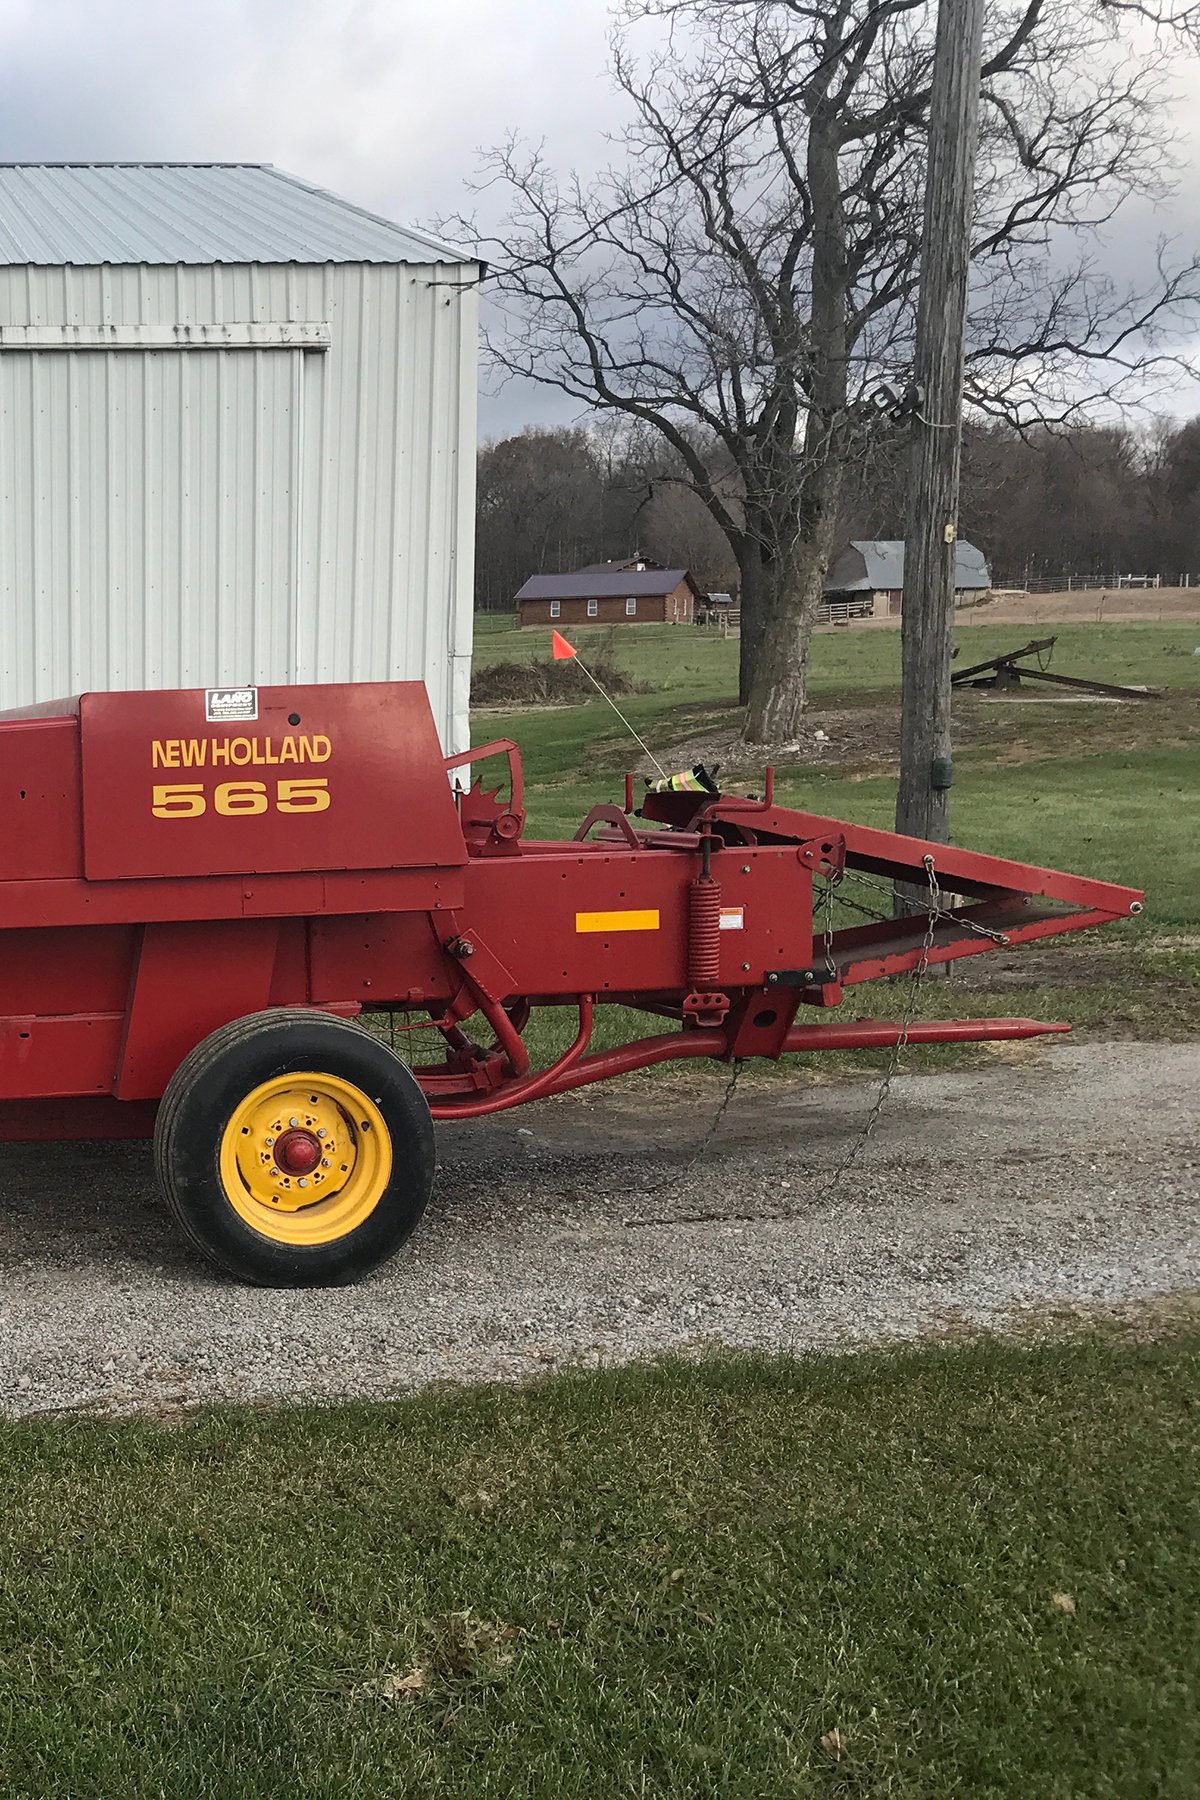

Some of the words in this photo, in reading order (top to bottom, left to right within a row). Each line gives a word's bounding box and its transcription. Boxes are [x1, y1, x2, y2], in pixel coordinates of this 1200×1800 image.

[152, 738, 207, 768] NEW
[212, 735, 332, 766] HOLLAND
[152, 778, 331, 819] 565
